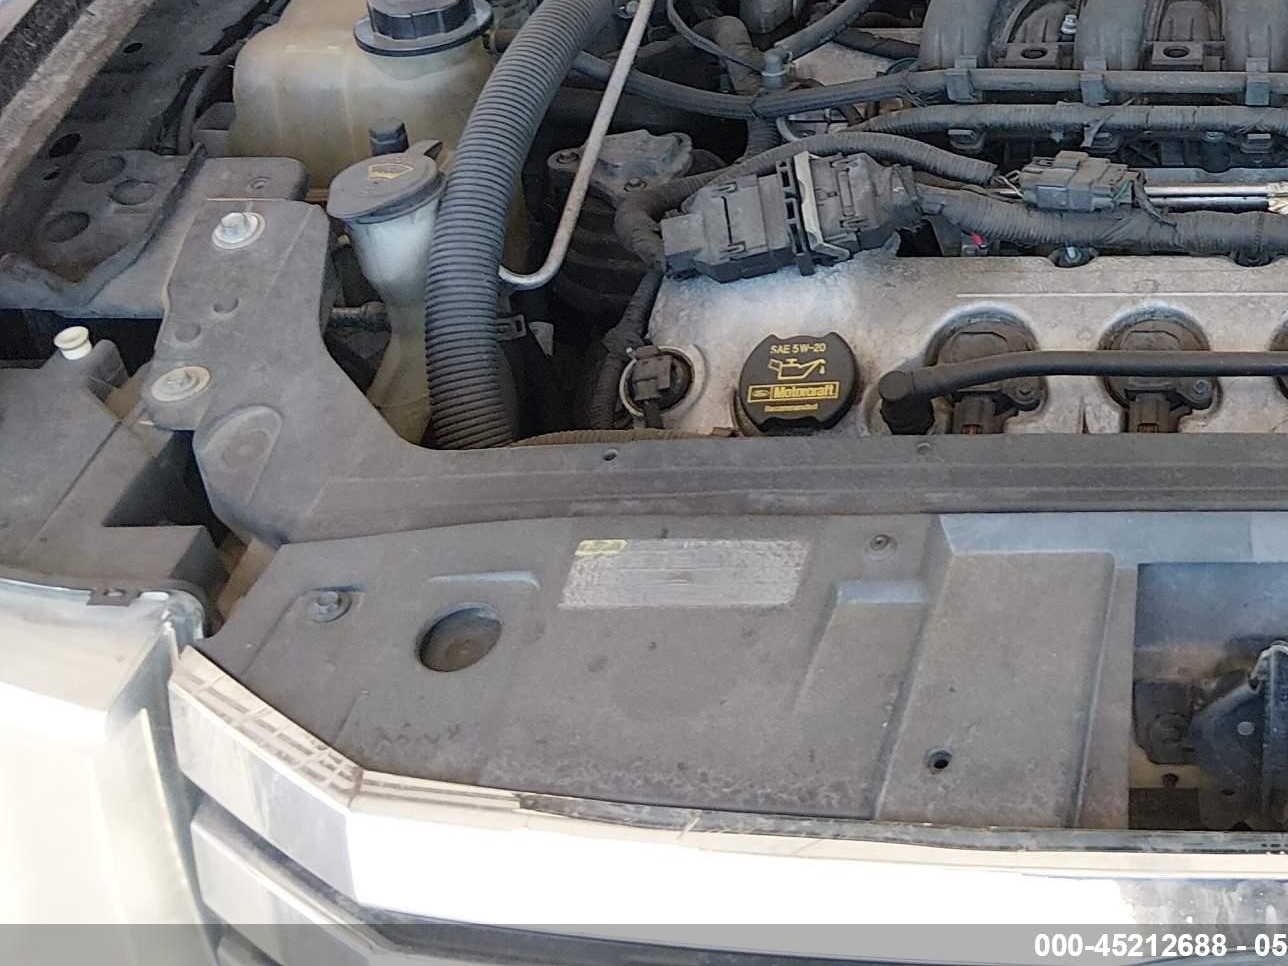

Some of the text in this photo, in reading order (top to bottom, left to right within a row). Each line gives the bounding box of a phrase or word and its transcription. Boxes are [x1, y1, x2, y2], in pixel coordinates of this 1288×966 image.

[770, 343, 826, 354] SAE 5W-20
[774, 384, 834, 398] Motorcraft
